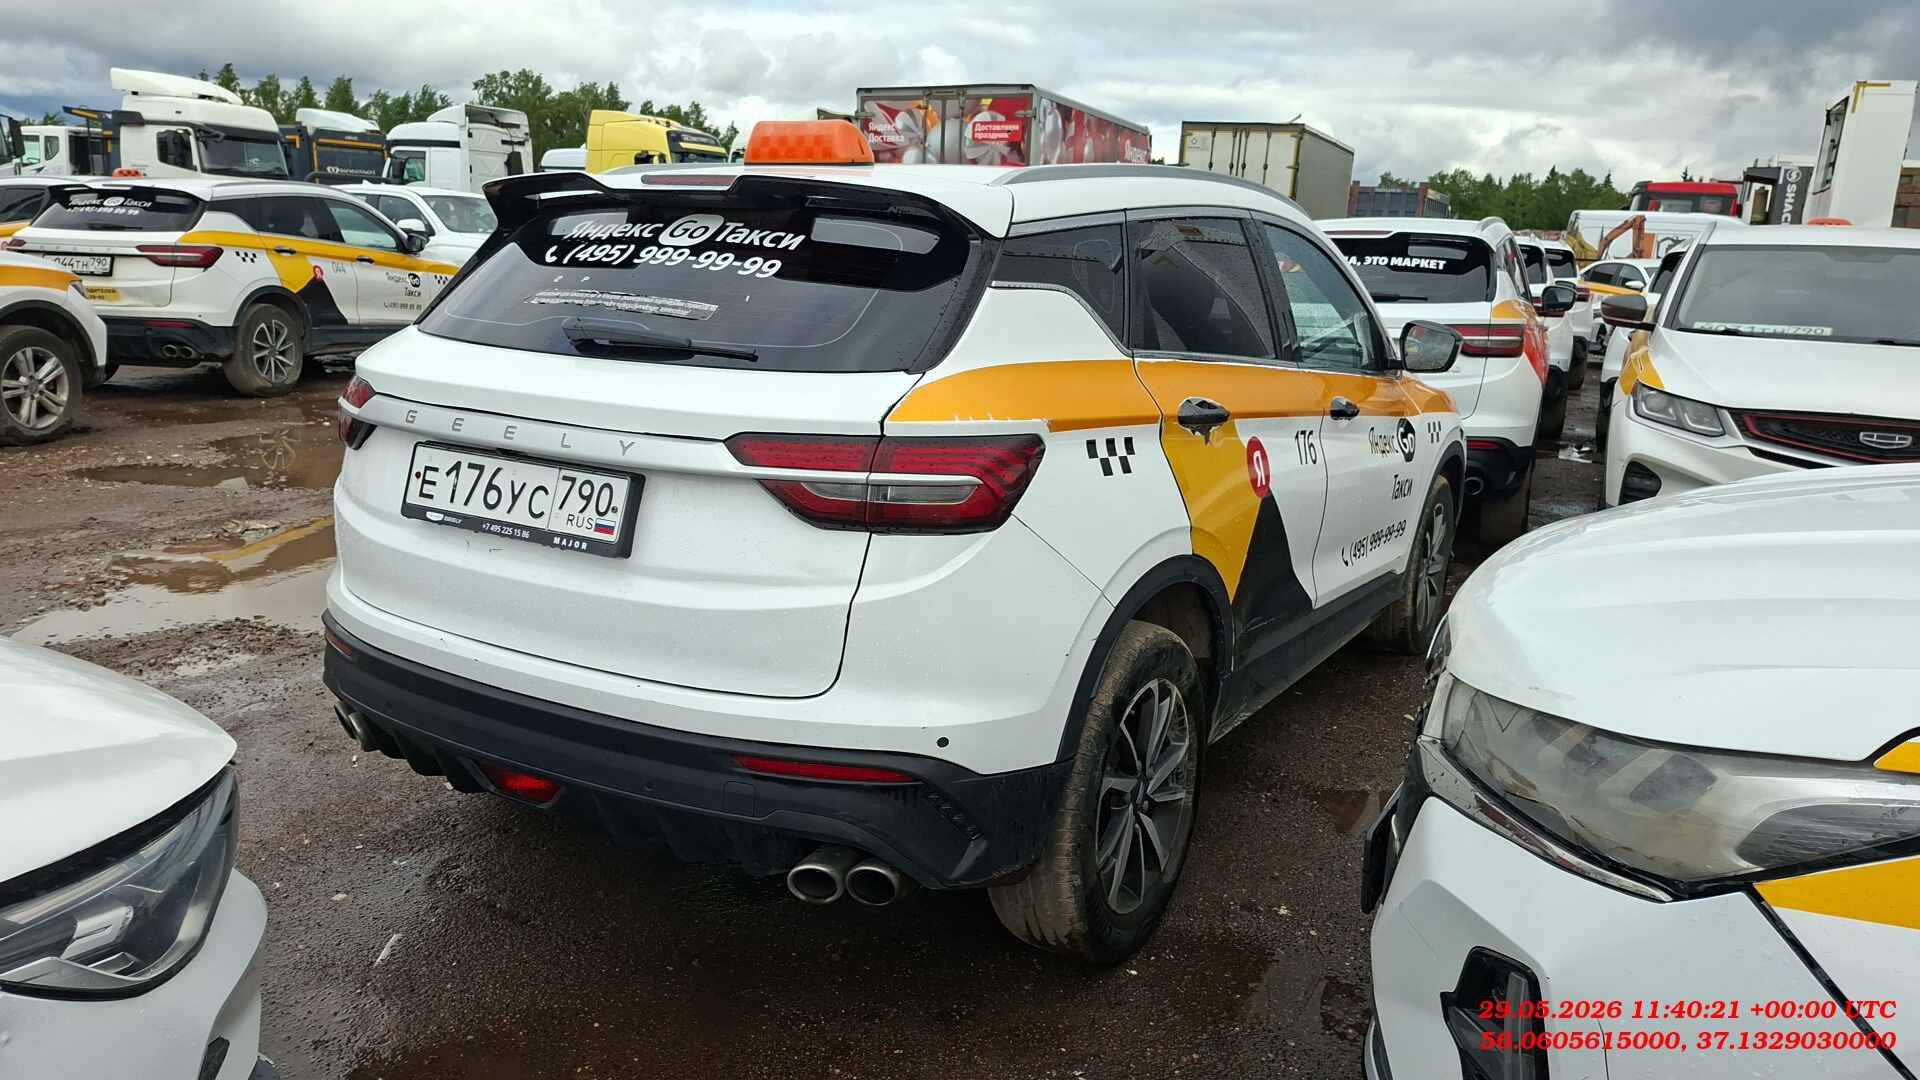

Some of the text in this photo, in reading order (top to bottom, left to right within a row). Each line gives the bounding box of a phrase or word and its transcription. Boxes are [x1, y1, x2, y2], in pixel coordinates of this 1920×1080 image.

[564, 220, 664, 241] Яндекс
[714, 221, 806, 251] Такси
[90, 257, 107, 267] 790
[563, 244, 783, 279] (495) 999-99-99
[1364, 255, 1389, 267] ЭТО
[1390, 257, 1447, 271] МАРКЕТ
[405, 409, 636, 457] GEELY
[1294, 429, 1318, 466] 176
[1368, 425, 1399, 458] Яндекс
[1252, 450, 1266, 488] Я
[557, 475, 614, 518] 790
[1391, 474, 1413, 501] Такси
[566, 513, 594, 531] RUS
[1369, 519, 1407, 552] 999-99-99
[553, 536, 588, 551] MAJOR
